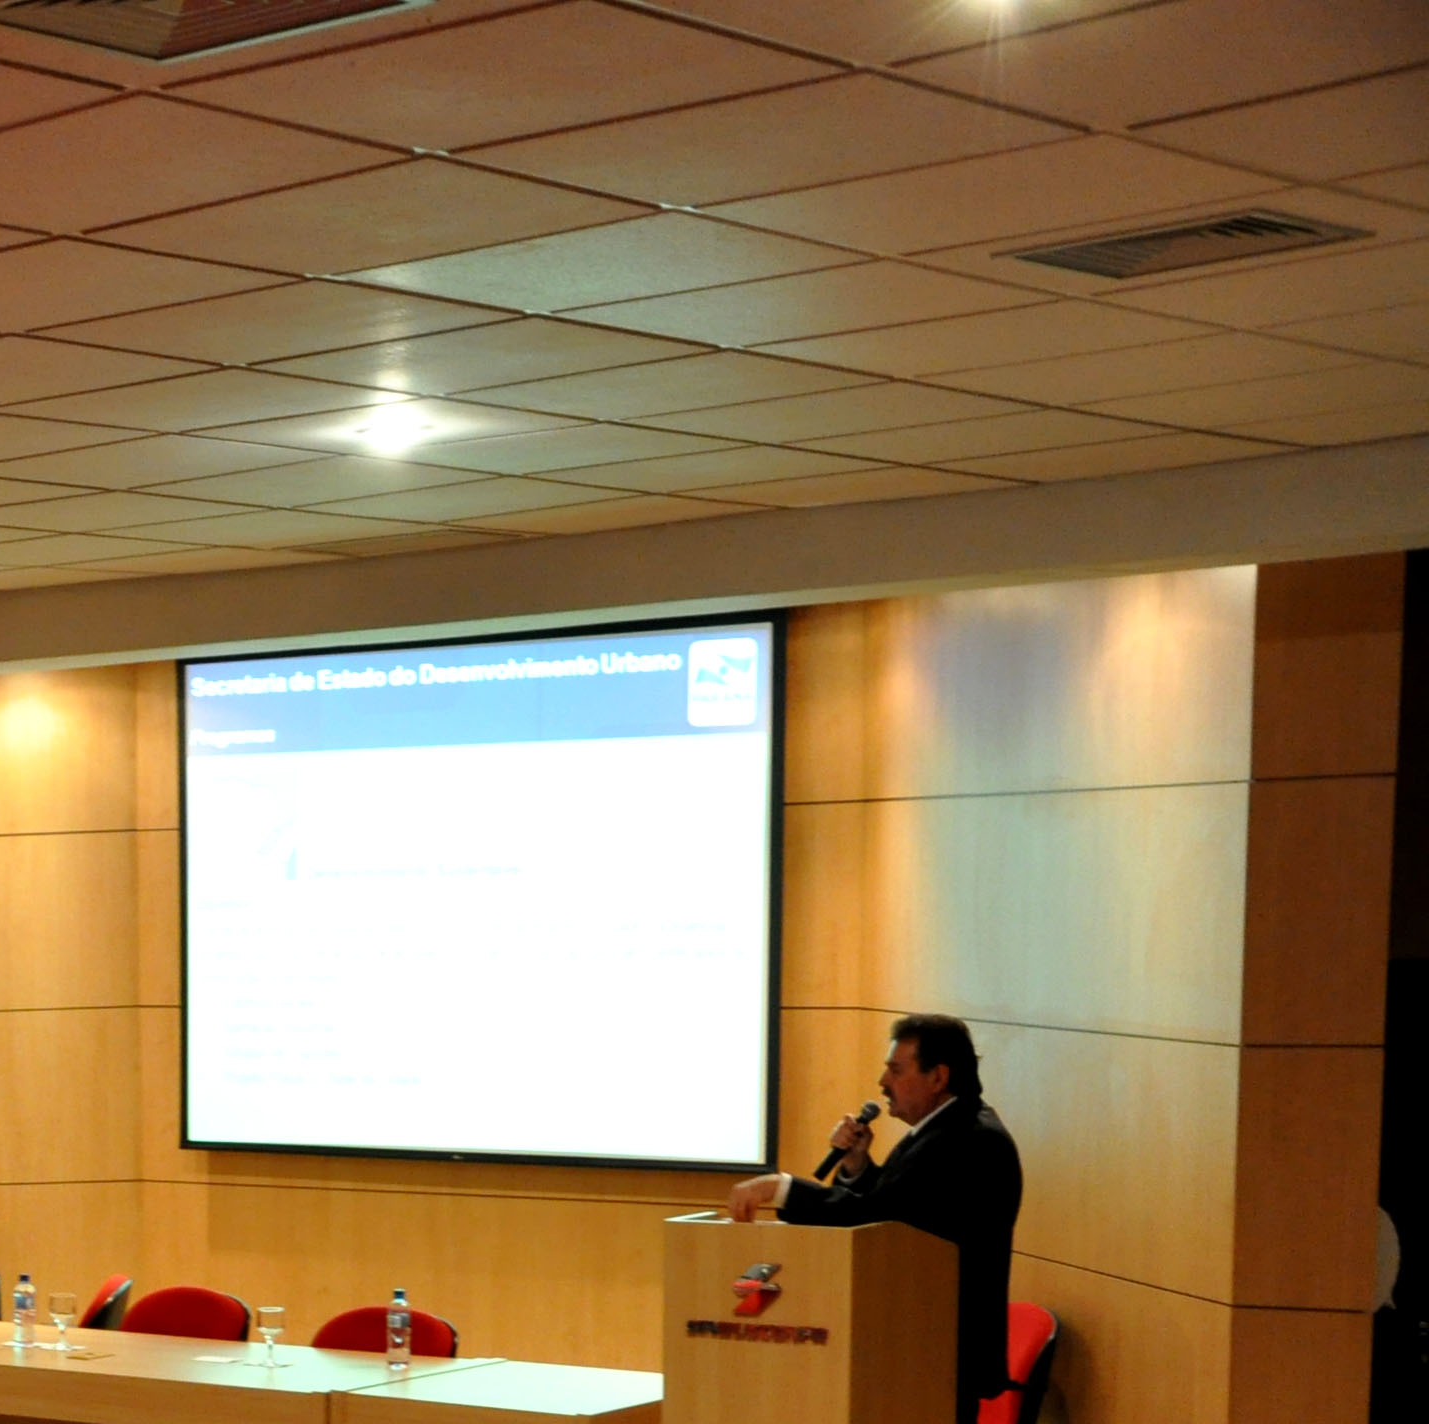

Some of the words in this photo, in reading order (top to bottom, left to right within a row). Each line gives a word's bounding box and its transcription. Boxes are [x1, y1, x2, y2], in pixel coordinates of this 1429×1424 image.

[190, 672, 288, 697] Secretaria
[289, 671, 315, 692] de
[317, 667, 387, 691] Estado
[388, 665, 417, 686] do
[419, 655, 599, 685] Desenvolvimento
[600, 652, 682, 675] Urbano
